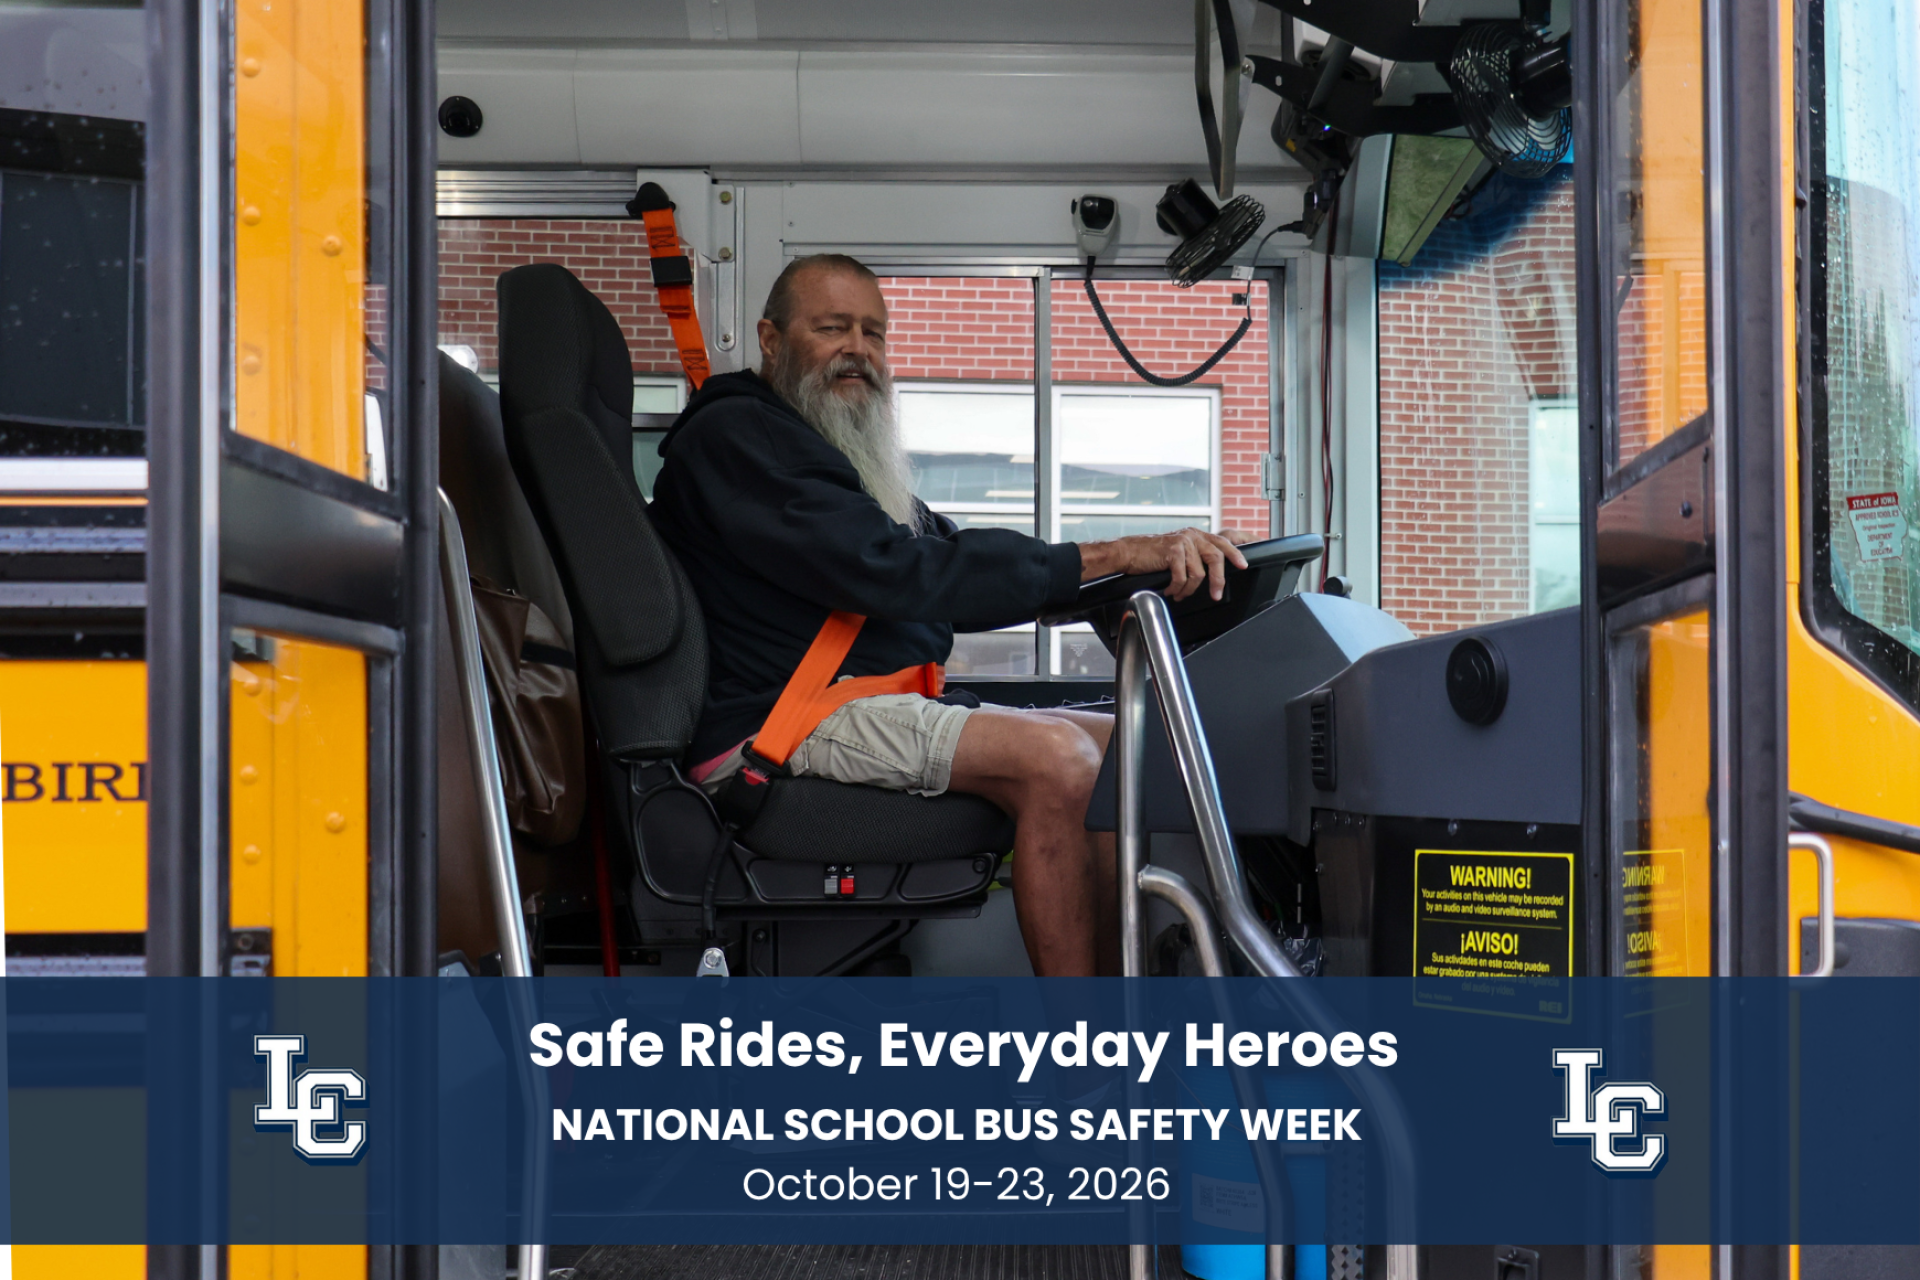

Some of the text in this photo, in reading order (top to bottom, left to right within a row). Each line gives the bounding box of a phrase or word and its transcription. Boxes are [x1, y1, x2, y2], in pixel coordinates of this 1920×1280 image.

[1852, 496, 1896, 509] STATE of IOWA
[1450, 865, 1531, 889] WARNING!
[1422, 888, 1564, 906] Your activities on this vehicle may be recorded
[1426, 901, 1558, 920] by an audio and video surveillance system.
[1460, 930, 1519, 955] ¡AVISO!
[1423, 965, 1438, 975] estar
[1439, 966, 1464, 978] grabado
[1432, 952, 1444, 963] Sus
[1479, 958, 1488, 967] en
[1488, 958, 1502, 969] este
[1503, 959, 1523, 971] coche
[1524, 961, 1550, 973] pueden
